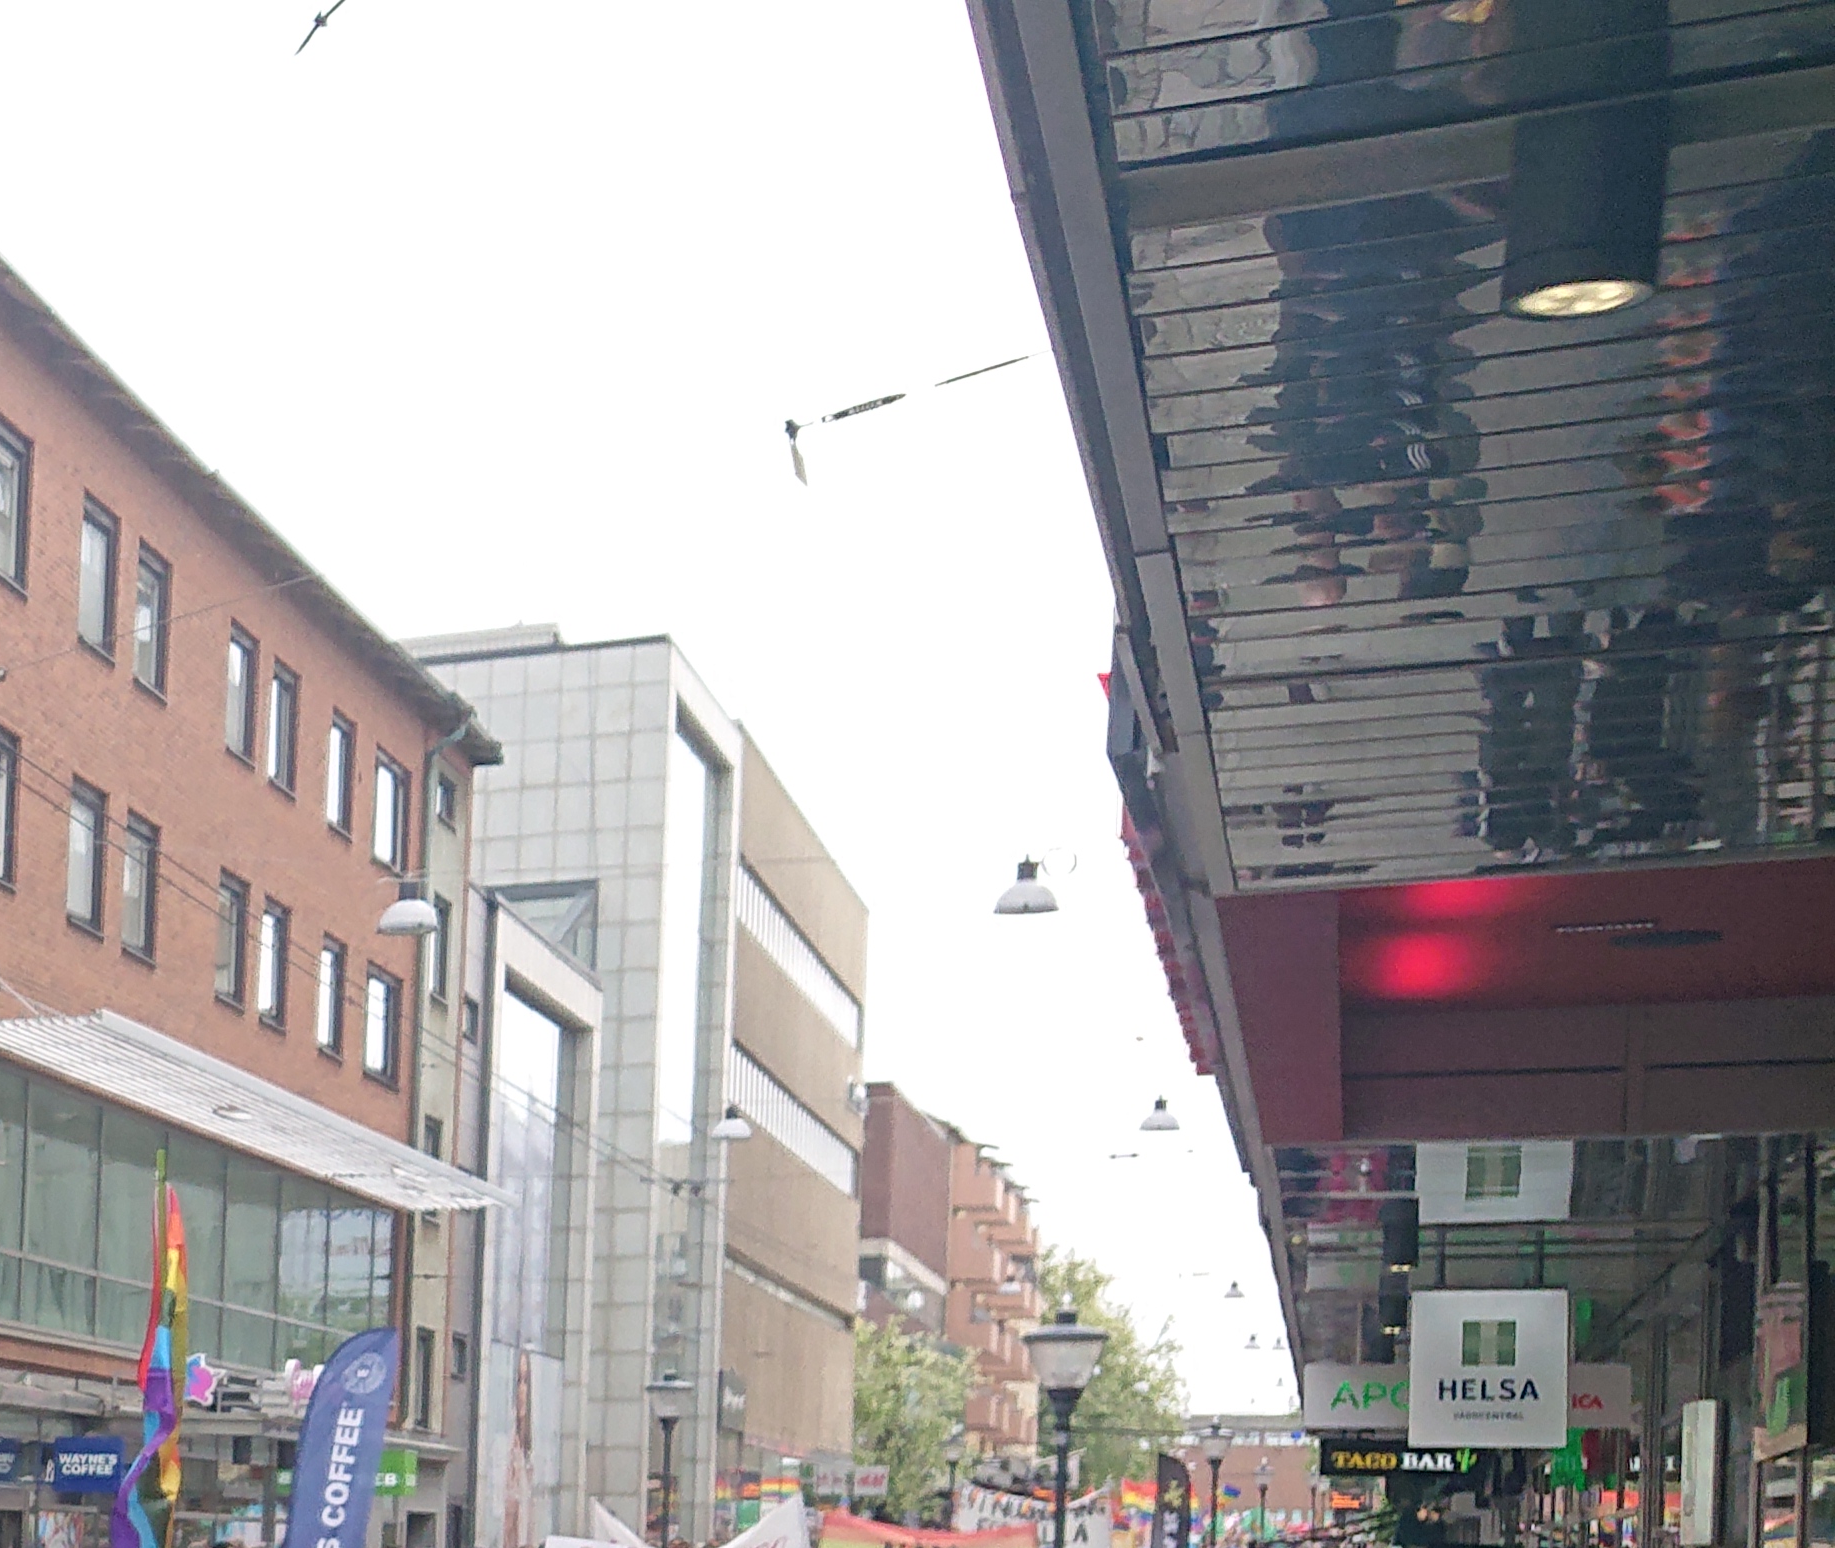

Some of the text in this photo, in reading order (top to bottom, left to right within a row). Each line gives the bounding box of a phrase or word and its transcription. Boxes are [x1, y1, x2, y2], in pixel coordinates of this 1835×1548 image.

[1331, 1380, 1410, 1411] APO
[1439, 1379, 1540, 1402] HELSA
[1572, 1393, 1604, 1410] ICA
[59, 1452, 117, 1464] WAYNE'S
[321, 1407, 365, 1528] COFFEE
[1331, 1452, 1455, 1472] TACO BAR
[62, 1463, 113, 1476] COFFEE
